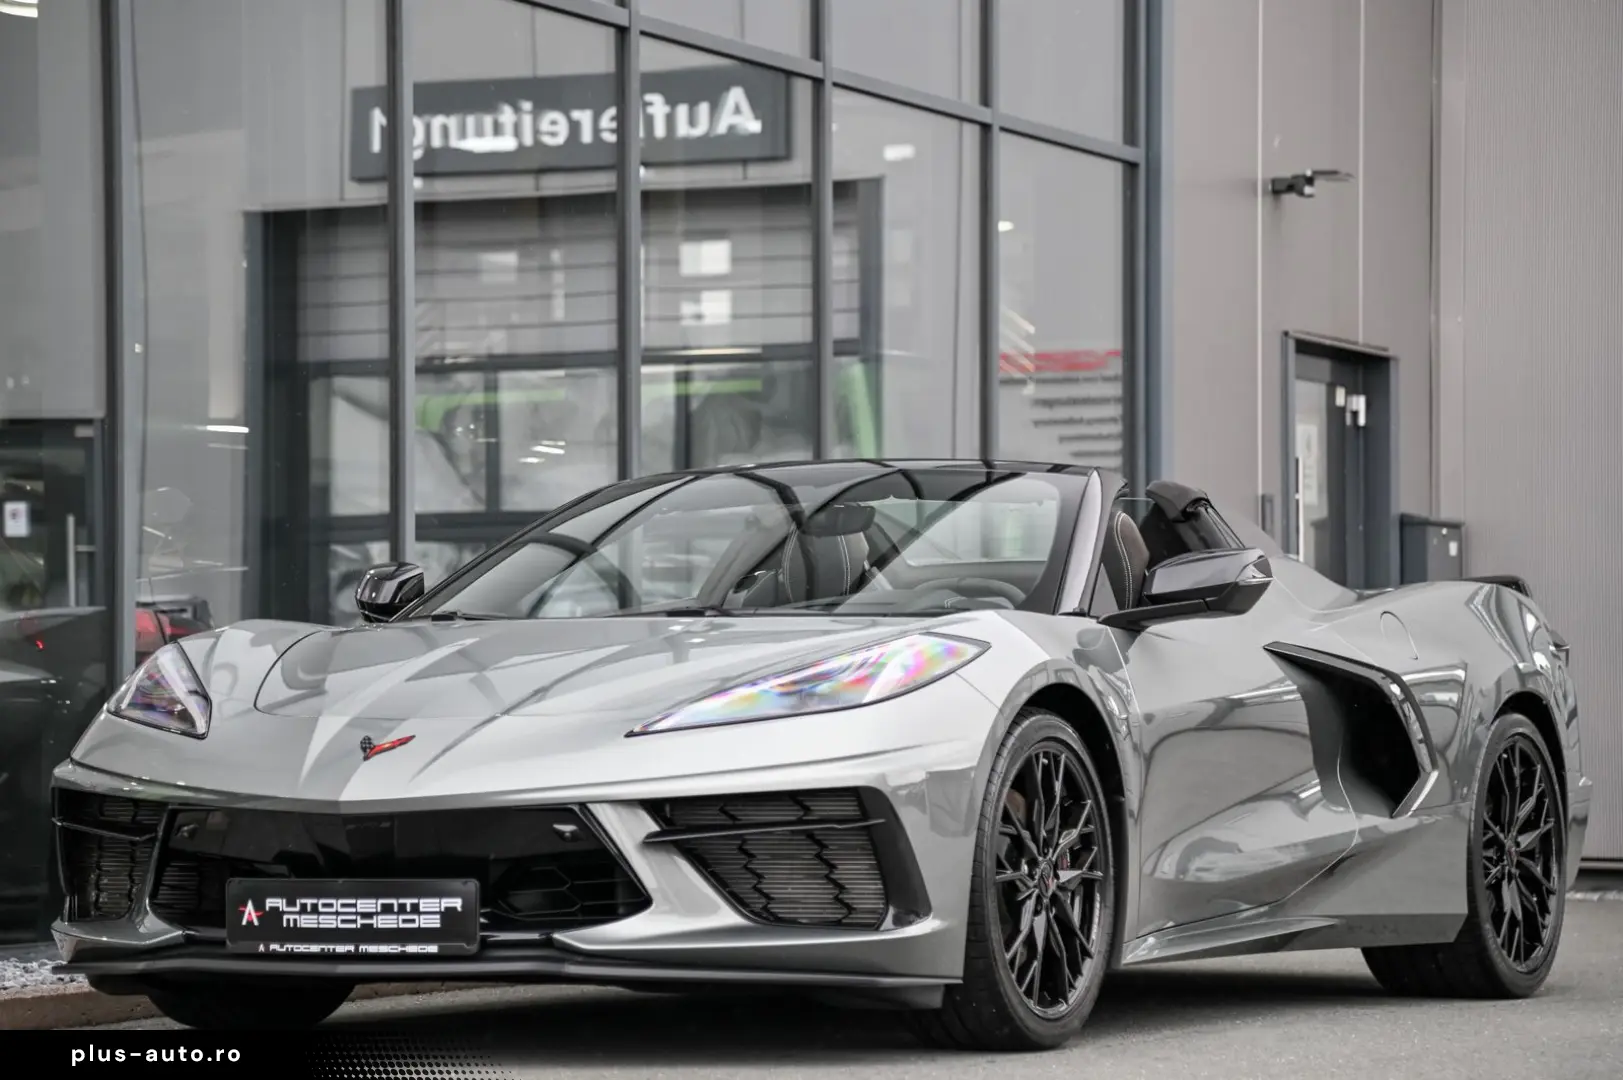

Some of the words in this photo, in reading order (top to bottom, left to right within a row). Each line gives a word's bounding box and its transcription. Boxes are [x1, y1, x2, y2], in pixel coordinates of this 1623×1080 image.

[265, 898, 463, 912] AUTOCENTER
[283, 914, 441, 928] MESCHEDE
[269, 944, 355, 953] AUTOCENTER
[359, 945, 439, 953] MESCHEDE
